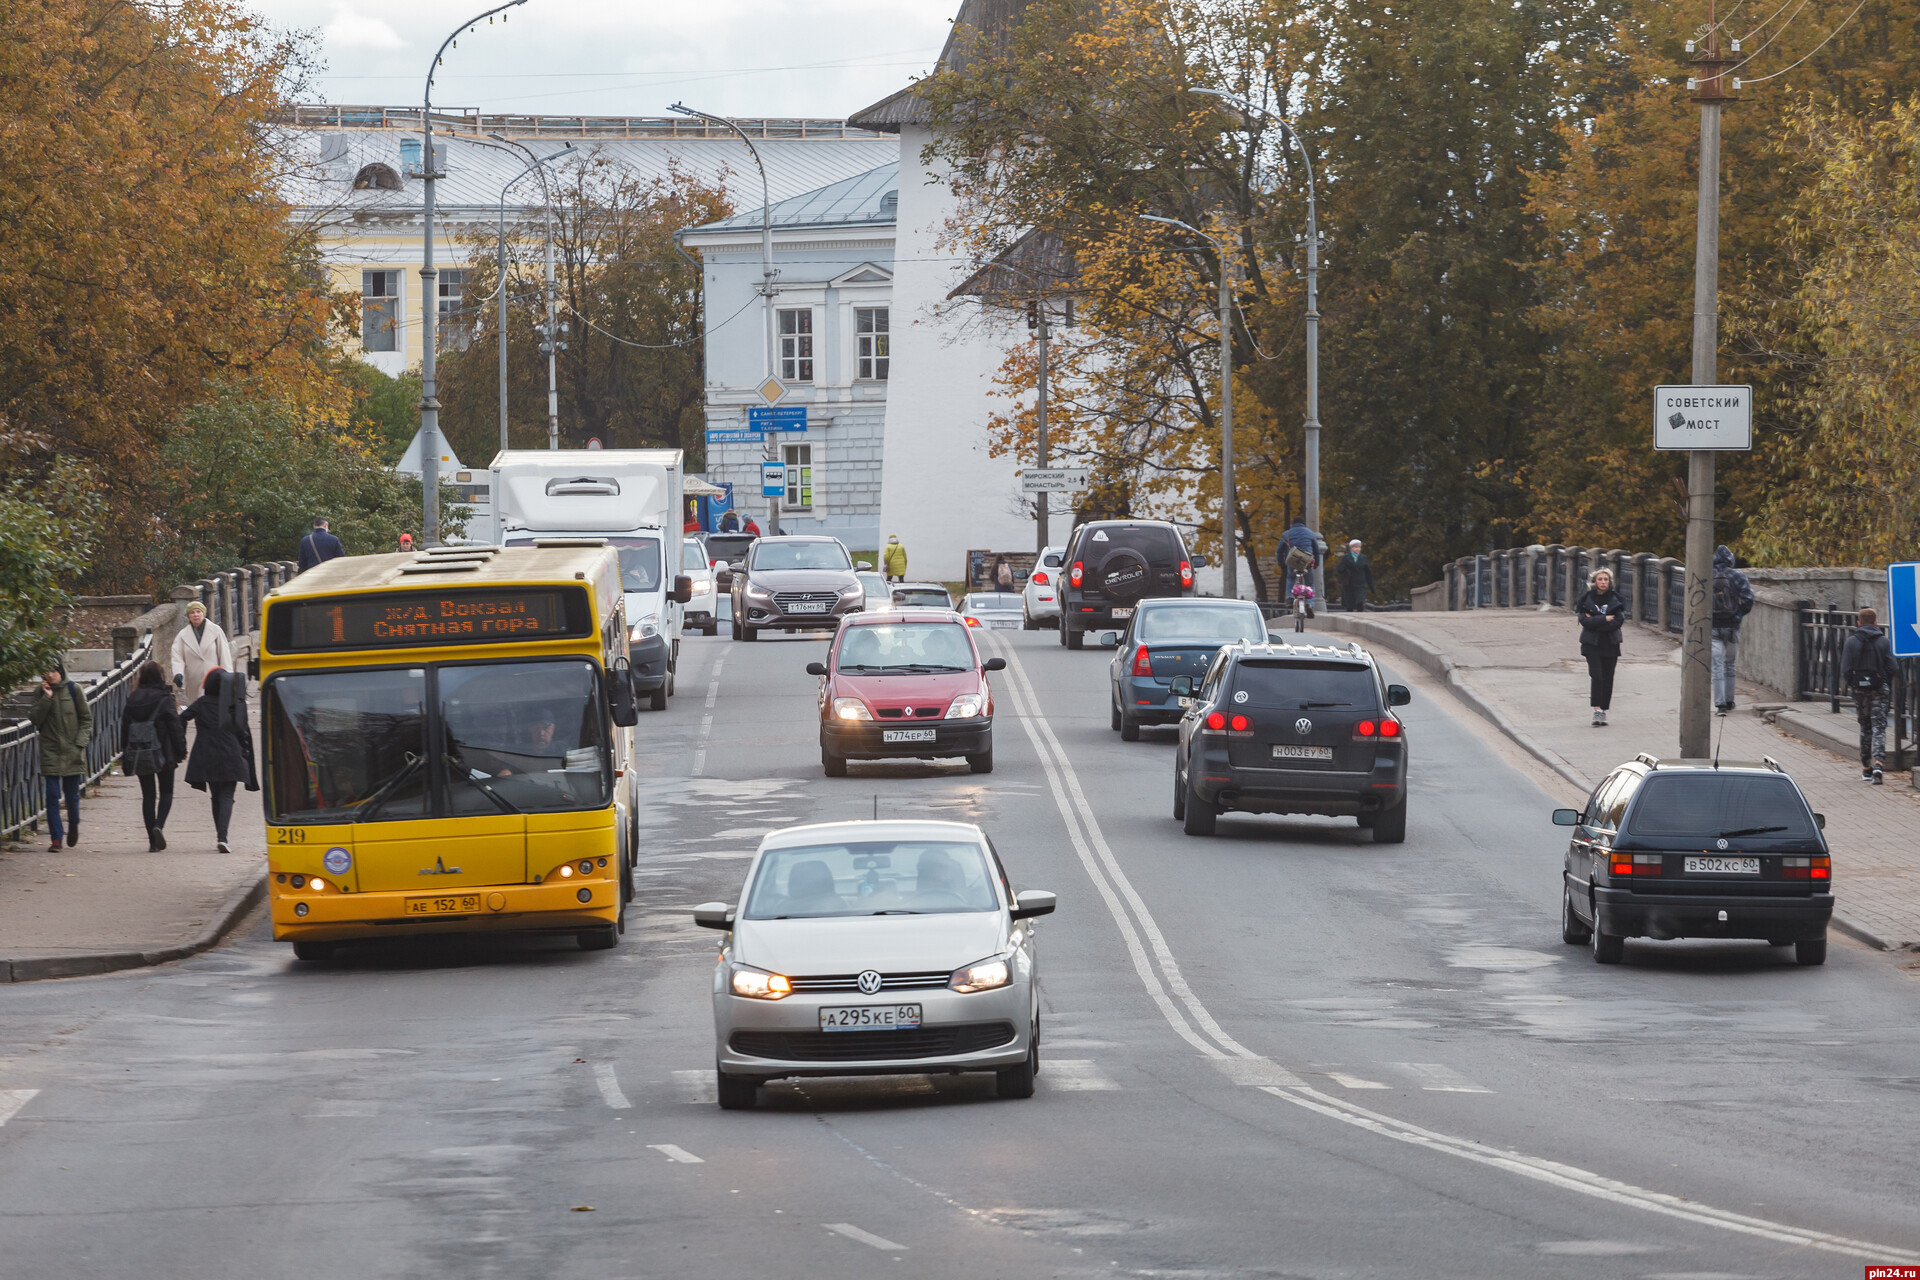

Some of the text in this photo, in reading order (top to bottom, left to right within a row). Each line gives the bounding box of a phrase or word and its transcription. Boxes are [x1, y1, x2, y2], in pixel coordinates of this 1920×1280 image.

[1666, 396, 1739, 408] СОВЕТСКИЙ
[1686, 419, 1720, 430] МОСТ
[1104, 570, 1144, 585] CHEVROLET
[440, 600, 526, 617] Вокзал
[326, 606, 346, 642] 1
[373, 617, 539, 638] Снятная гора
[277, 827, 306, 844] 219
